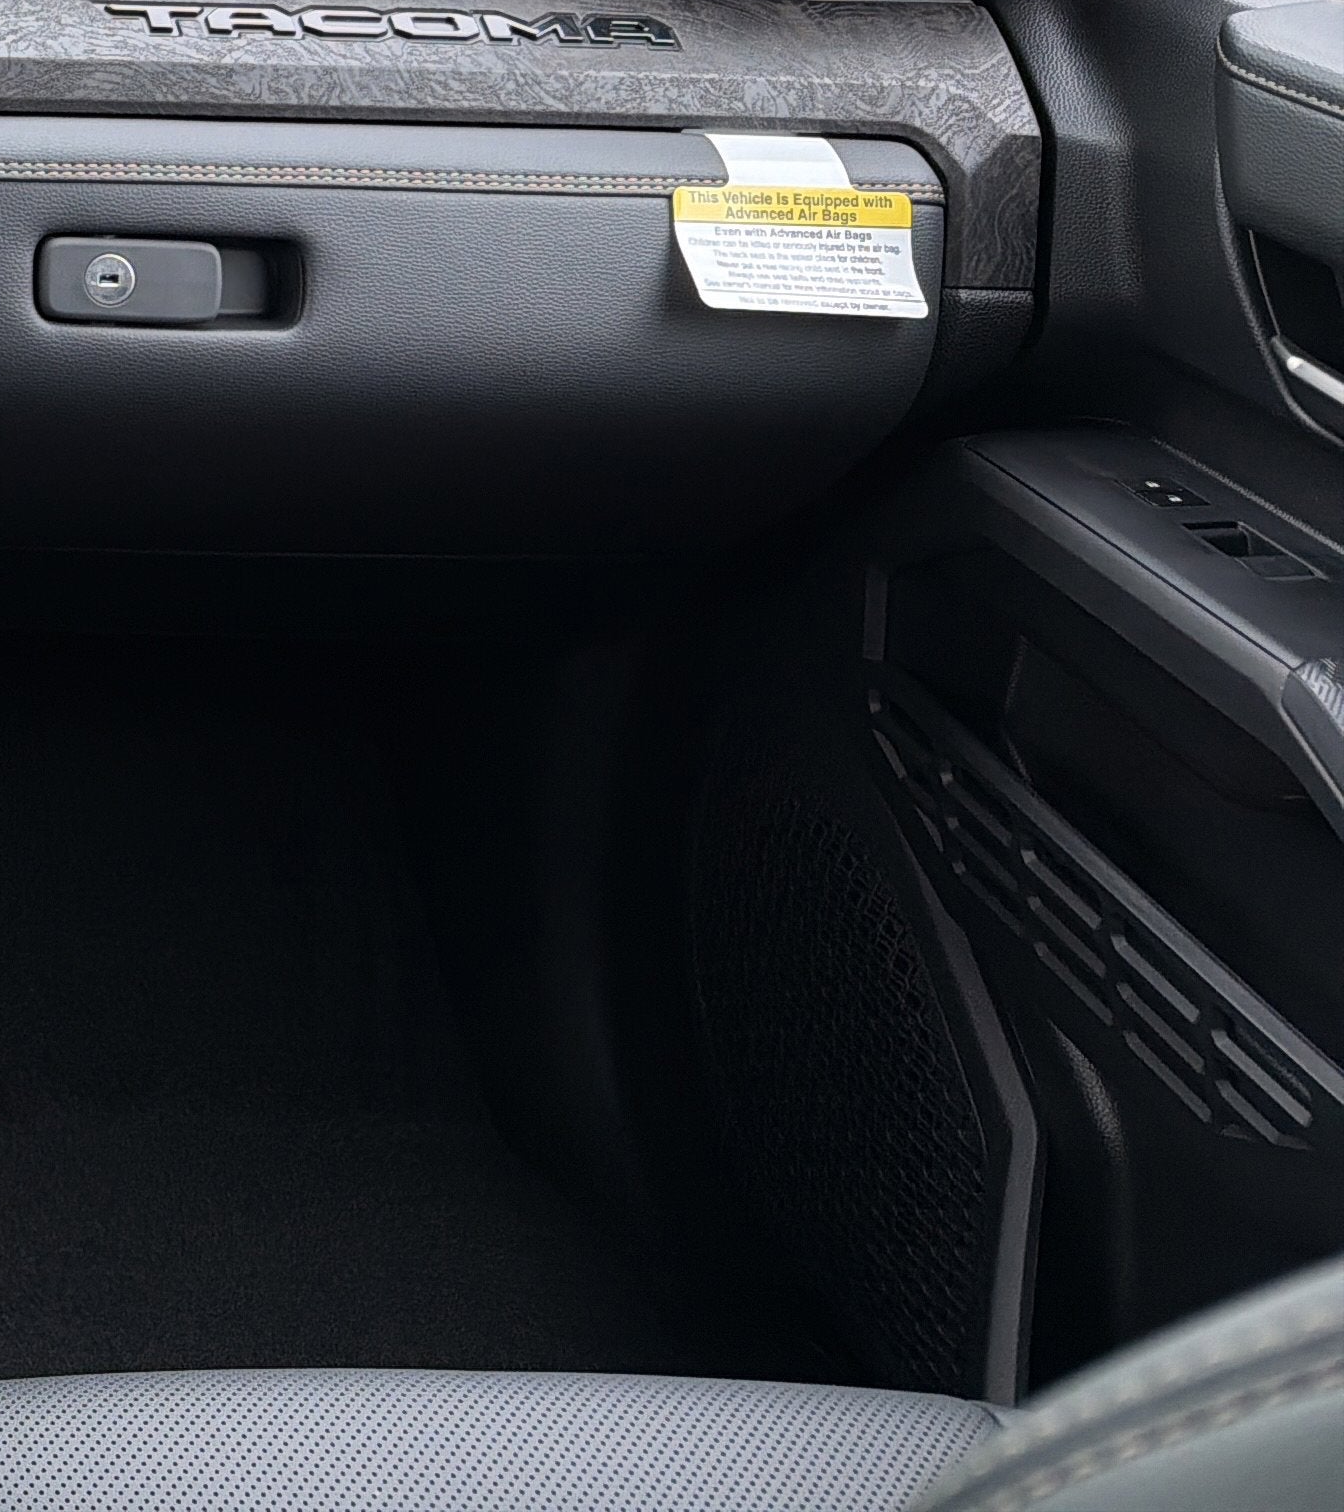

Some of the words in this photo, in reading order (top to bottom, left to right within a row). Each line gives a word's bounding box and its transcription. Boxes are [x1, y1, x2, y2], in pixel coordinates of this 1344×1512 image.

[100, 0, 683, 49] TACOMA
[688, 190, 719, 204] This
[722, 191, 772, 205] Vehicle
[777, 193, 788, 205] Is
[793, 193, 859, 209] Equipped
[863, 196, 892, 208] with
[725, 206, 794, 220] Advanced
[798, 208, 817, 221] Air
[822, 210, 857, 224] Bags
[770, 228, 822, 239] Advanced
[826, 230, 841, 239] Air
[845, 230, 872, 242] Bags
